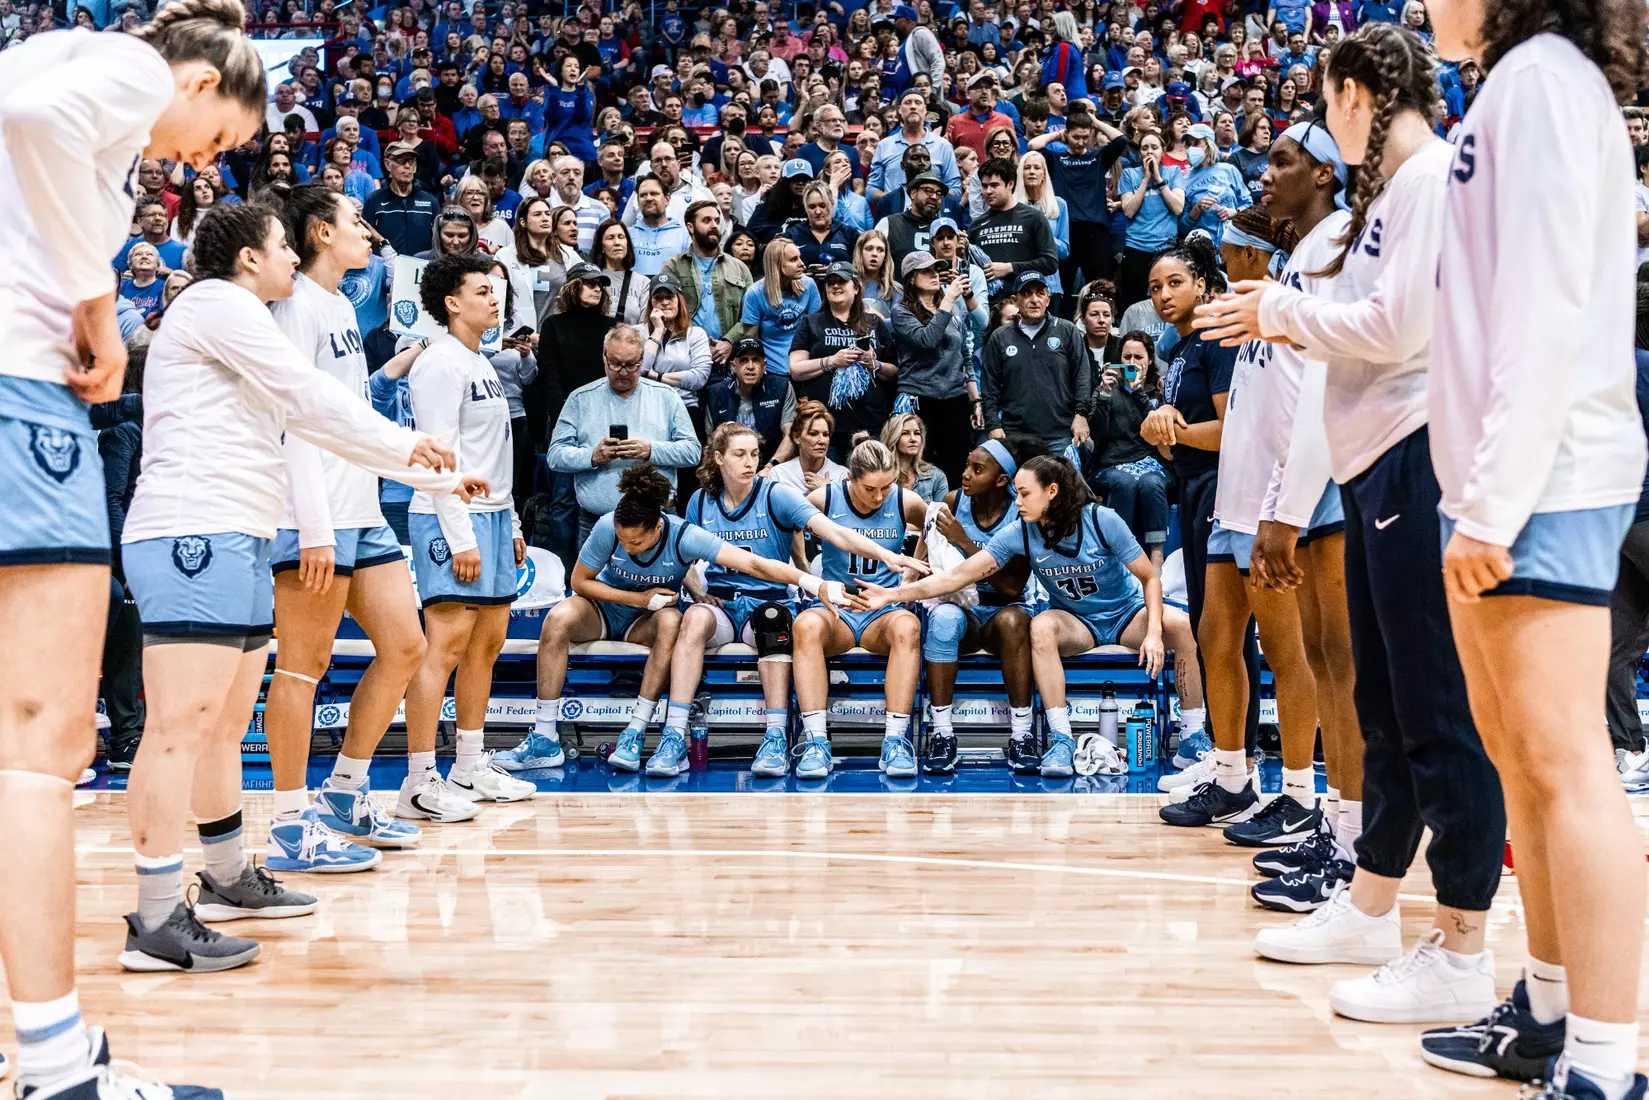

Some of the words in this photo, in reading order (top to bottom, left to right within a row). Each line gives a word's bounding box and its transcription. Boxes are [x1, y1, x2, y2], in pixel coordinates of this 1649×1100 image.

[979, 225, 1024, 236] COLUMBIA
[980, 238, 1019, 246] BASKETBALL
[824, 327, 876, 337] COLUA
[824, 336, 877, 348] UNIVEY
[1039, 558, 1105, 577] COLUMBIA
[1055, 575, 1099, 602] 35
[585, 706, 621, 716] Capitol
[706, 706, 742, 716] Capitol
[745, 706, 768, 716] Fede
[829, 705, 865, 716] Capitol
[951, 706, 987, 717] Capitol
[1075, 705, 1100, 716] Capi
